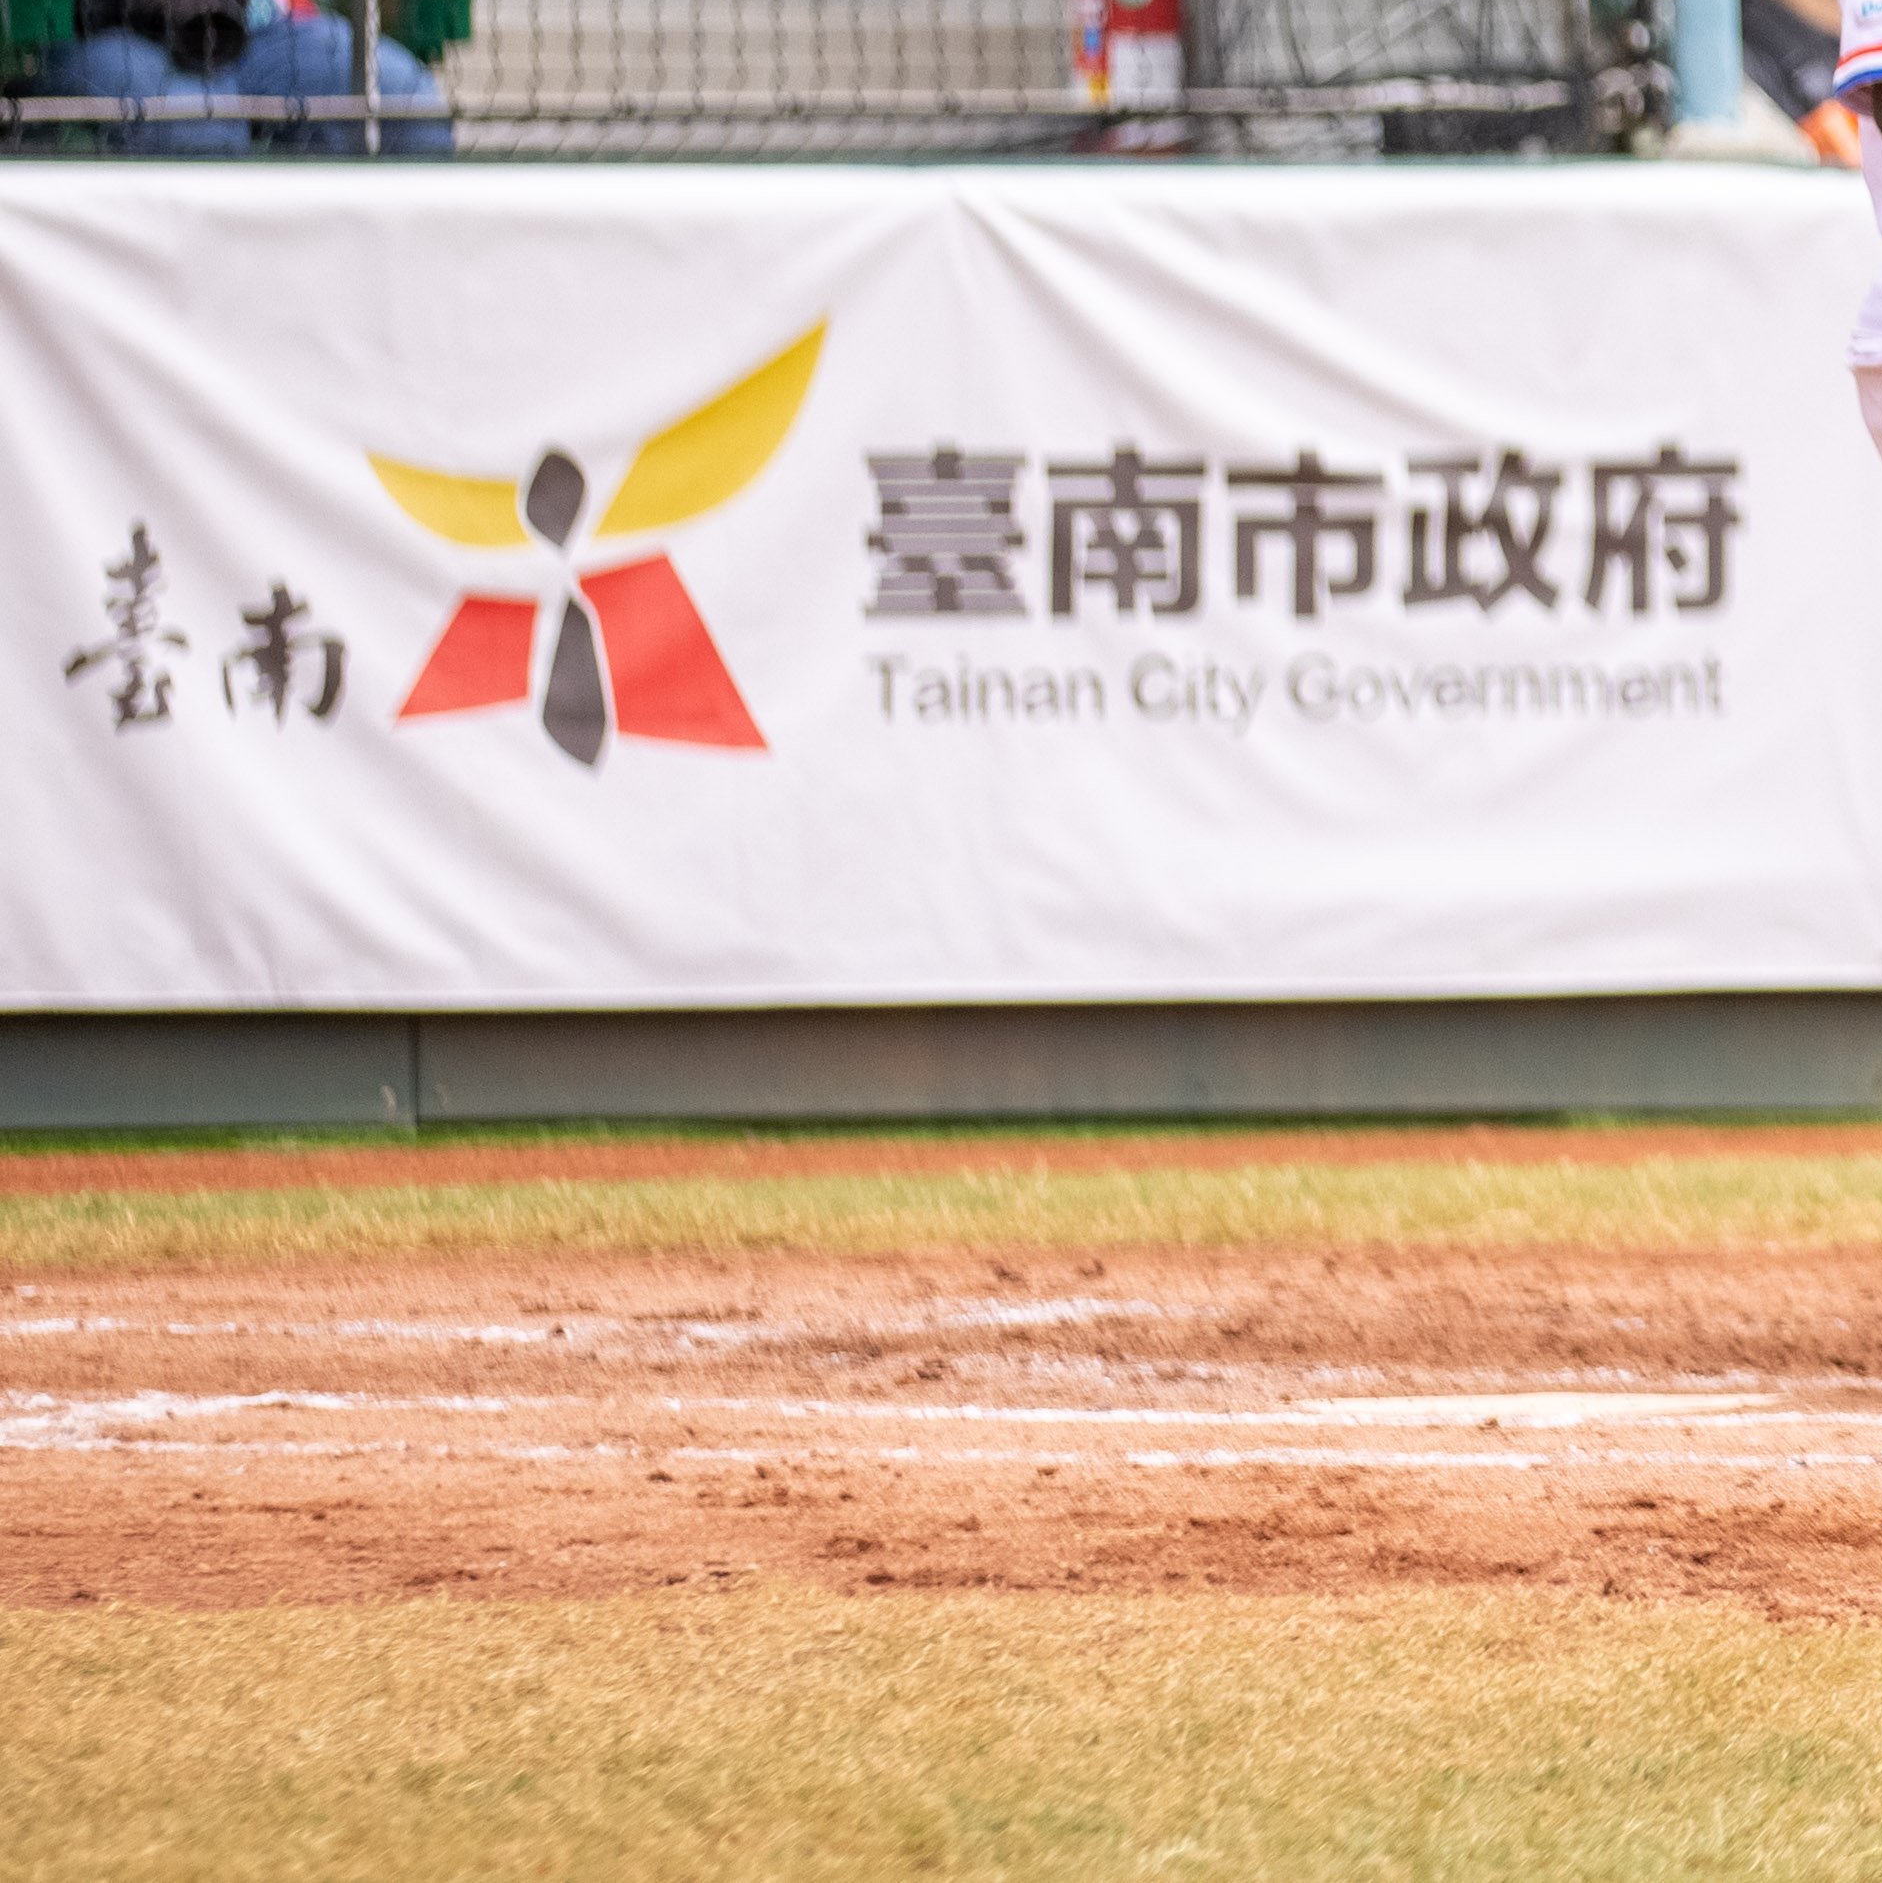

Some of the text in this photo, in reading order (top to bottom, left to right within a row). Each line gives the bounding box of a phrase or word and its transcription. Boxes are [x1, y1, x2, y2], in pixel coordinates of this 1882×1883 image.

[863, 442, 1743, 620] 臺南市政府
[865, 650, 1726, 737] Tainan City Government
